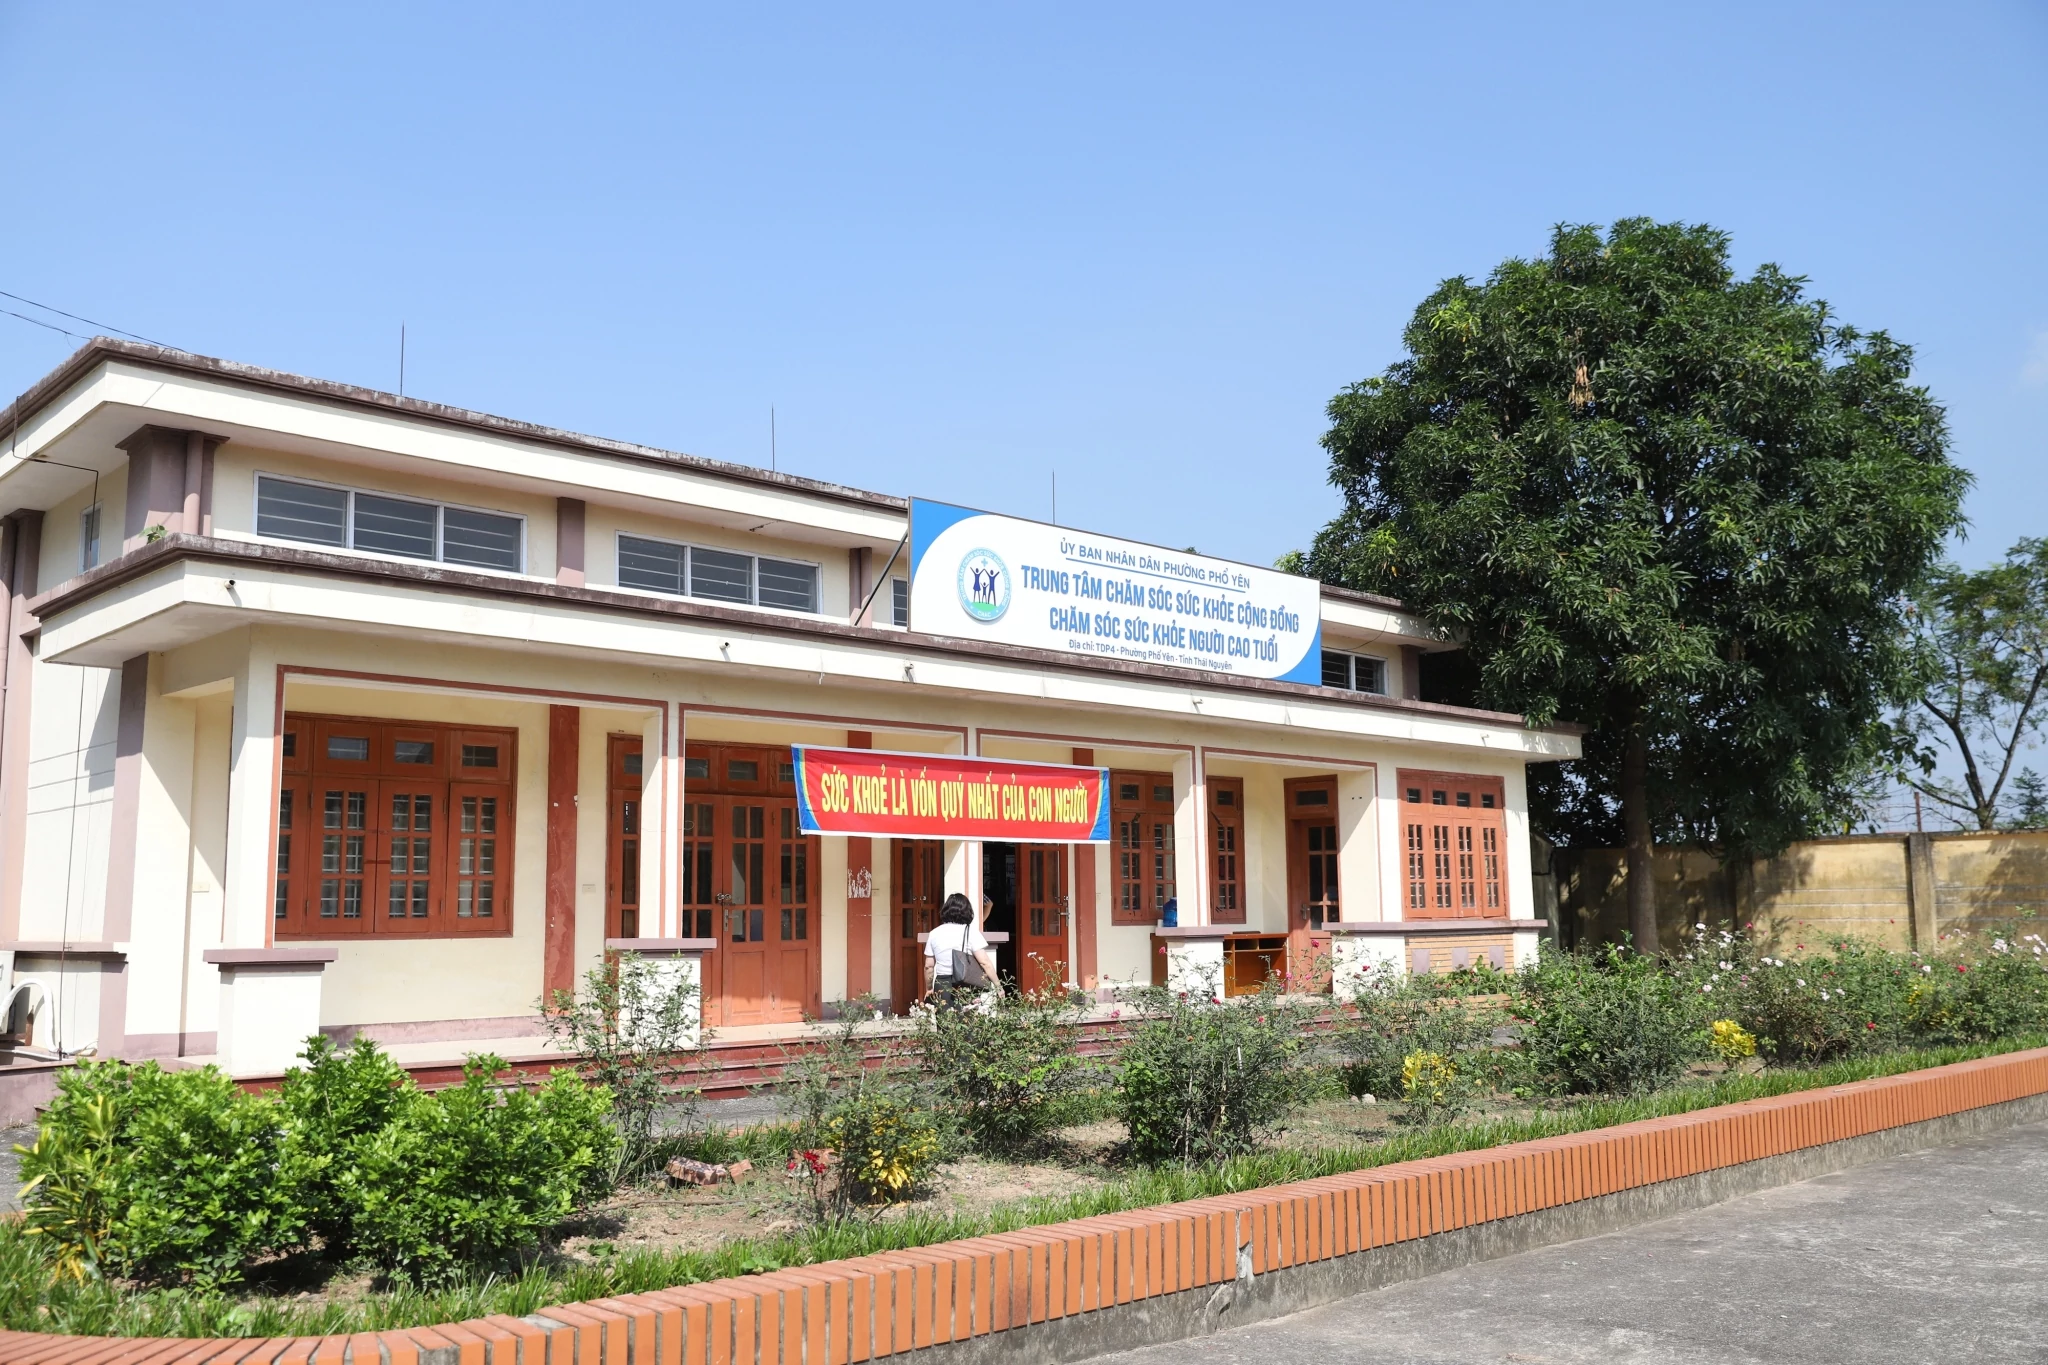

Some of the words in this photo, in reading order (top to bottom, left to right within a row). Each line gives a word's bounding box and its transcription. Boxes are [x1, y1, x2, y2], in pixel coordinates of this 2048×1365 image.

[1060, 537, 1076, 555] ỦY
[1079, 544, 1102, 561] BAN
[1106, 550, 1136, 567] NHÂN
[1139, 556, 1161, 572] DÂN
[1164, 561, 1206, 581] PHƯỜNG
[1208, 567, 1229, 585] PHỔ
[1231, 573, 1250, 589] YÊN
[1021, 564, 1069, 595] TRUNG
[1072, 570, 1102, 601] TÂM
[1106, 578, 1145, 607] CHĂM
[1148, 584, 1173, 612] SÓC
[1176, 589, 1200, 617] SỨC
[1203, 594, 1235, 623] KHỎE
[1237, 600, 1267, 630] CỘNG
[1270, 605, 1300, 634] ĐỒNG
[1049, 605, 1090, 635] CHĂM
[1094, 611, 1120, 639] SÓC
[1124, 616, 1149, 643] SỨC
[1152, 619, 1186, 649] KHỎE
[1189, 628, 1225, 655] NGƯỜI
[1227, 635, 1250, 658] CAO
[1253, 634, 1278, 663] TUỔI
[1069, 639, 1081, 651] Địa
[1096, 643, 1115, 654] TDP4
[1120, 646, 1147, 661] Phường
[1162, 652, 1175, 662] Yên
[1208, 659, 1232, 671] Nguyên
[821, 766, 850, 813] SỨC
[853, 763, 888, 815] KHOẺ
[891, 770, 909, 815] LÀ
[911, 766, 938, 818] VỐN
[940, 774, 965, 823] QUÝ
[968, 771, 999, 820] NHẤT
[1002, 772, 1026, 821] CỦA
[1028, 786, 1052, 823] CON
[1055, 780, 1089, 824] NGƯỜI
